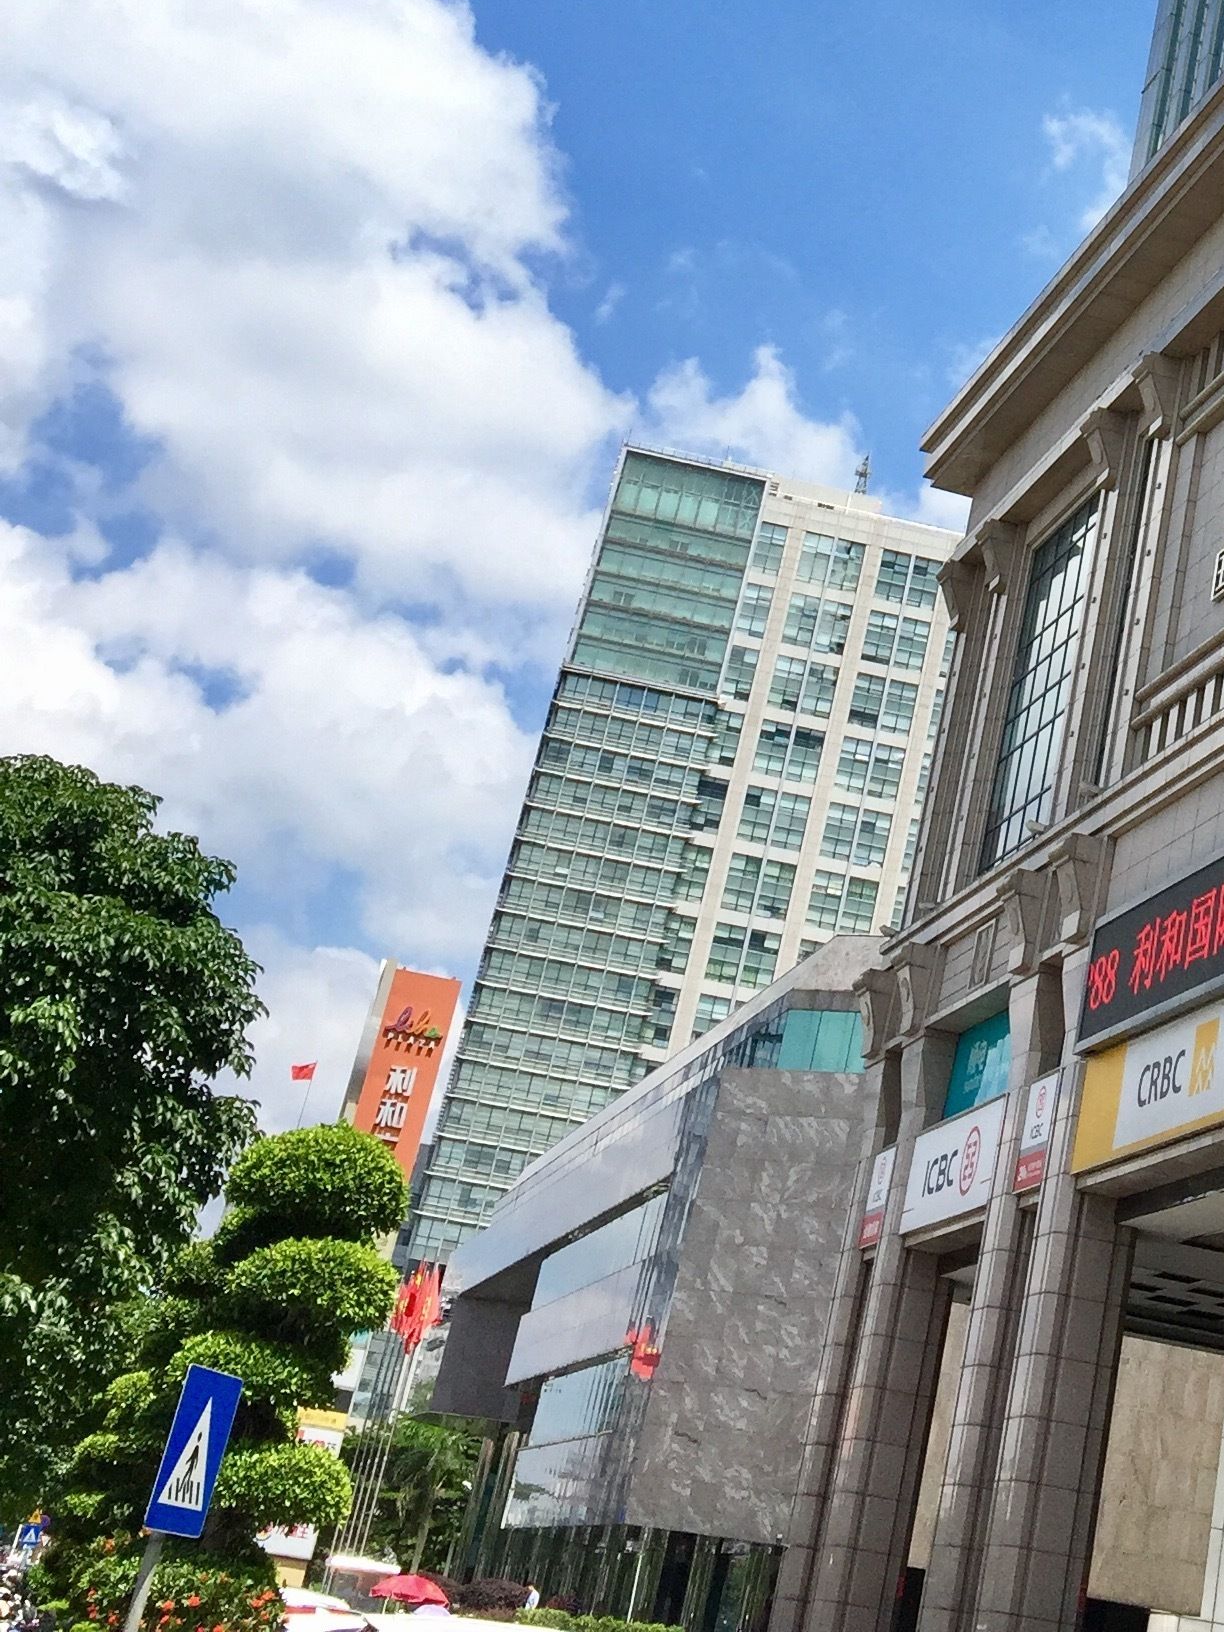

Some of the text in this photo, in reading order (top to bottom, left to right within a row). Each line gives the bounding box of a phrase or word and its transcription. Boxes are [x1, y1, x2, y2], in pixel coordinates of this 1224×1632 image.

[375, 1065, 418, 1142] 利和
[1137, 1049, 1186, 1108] CRBC
[921, 1148, 959, 1198] ICBC
